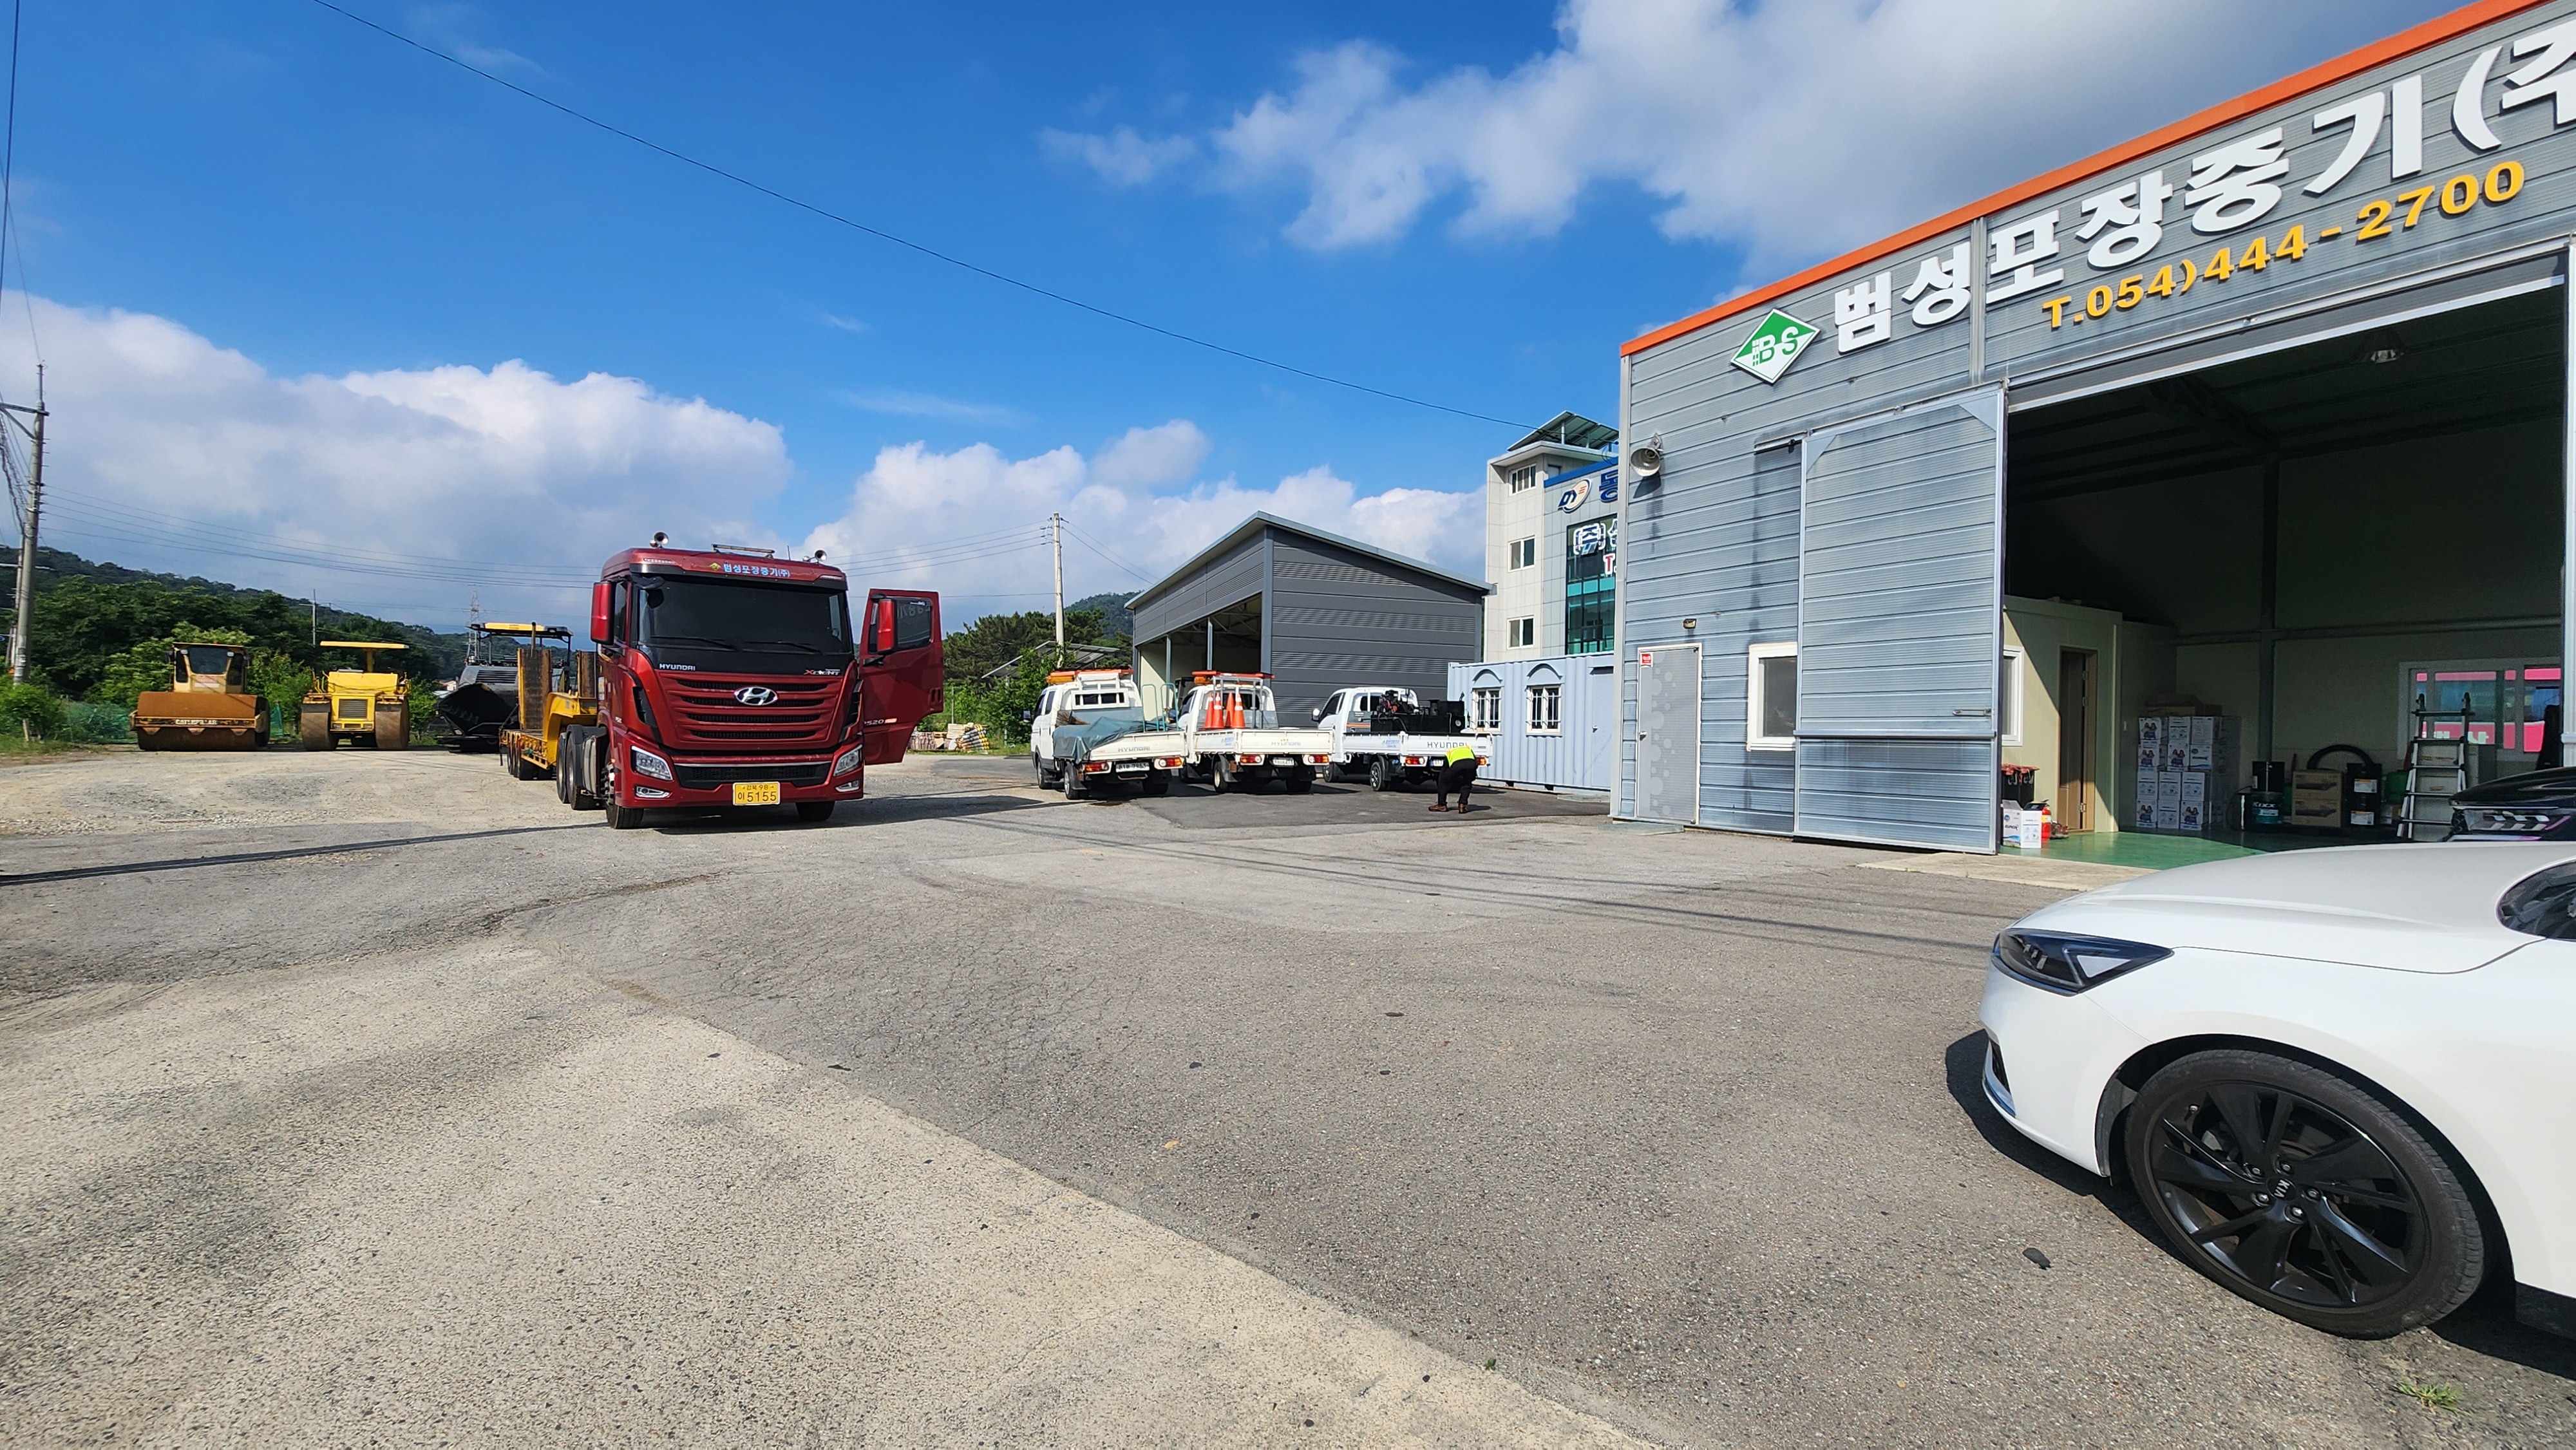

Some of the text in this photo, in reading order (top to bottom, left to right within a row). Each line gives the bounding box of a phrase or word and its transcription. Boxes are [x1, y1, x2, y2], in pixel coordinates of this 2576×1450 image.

[723, 563, 791, 578] 범성포장중기(주)
[659, 663, 696, 672] HYUNDAI
[746, 791, 777, 802] 5155
[2273, 1180, 2290, 1198] KIA
